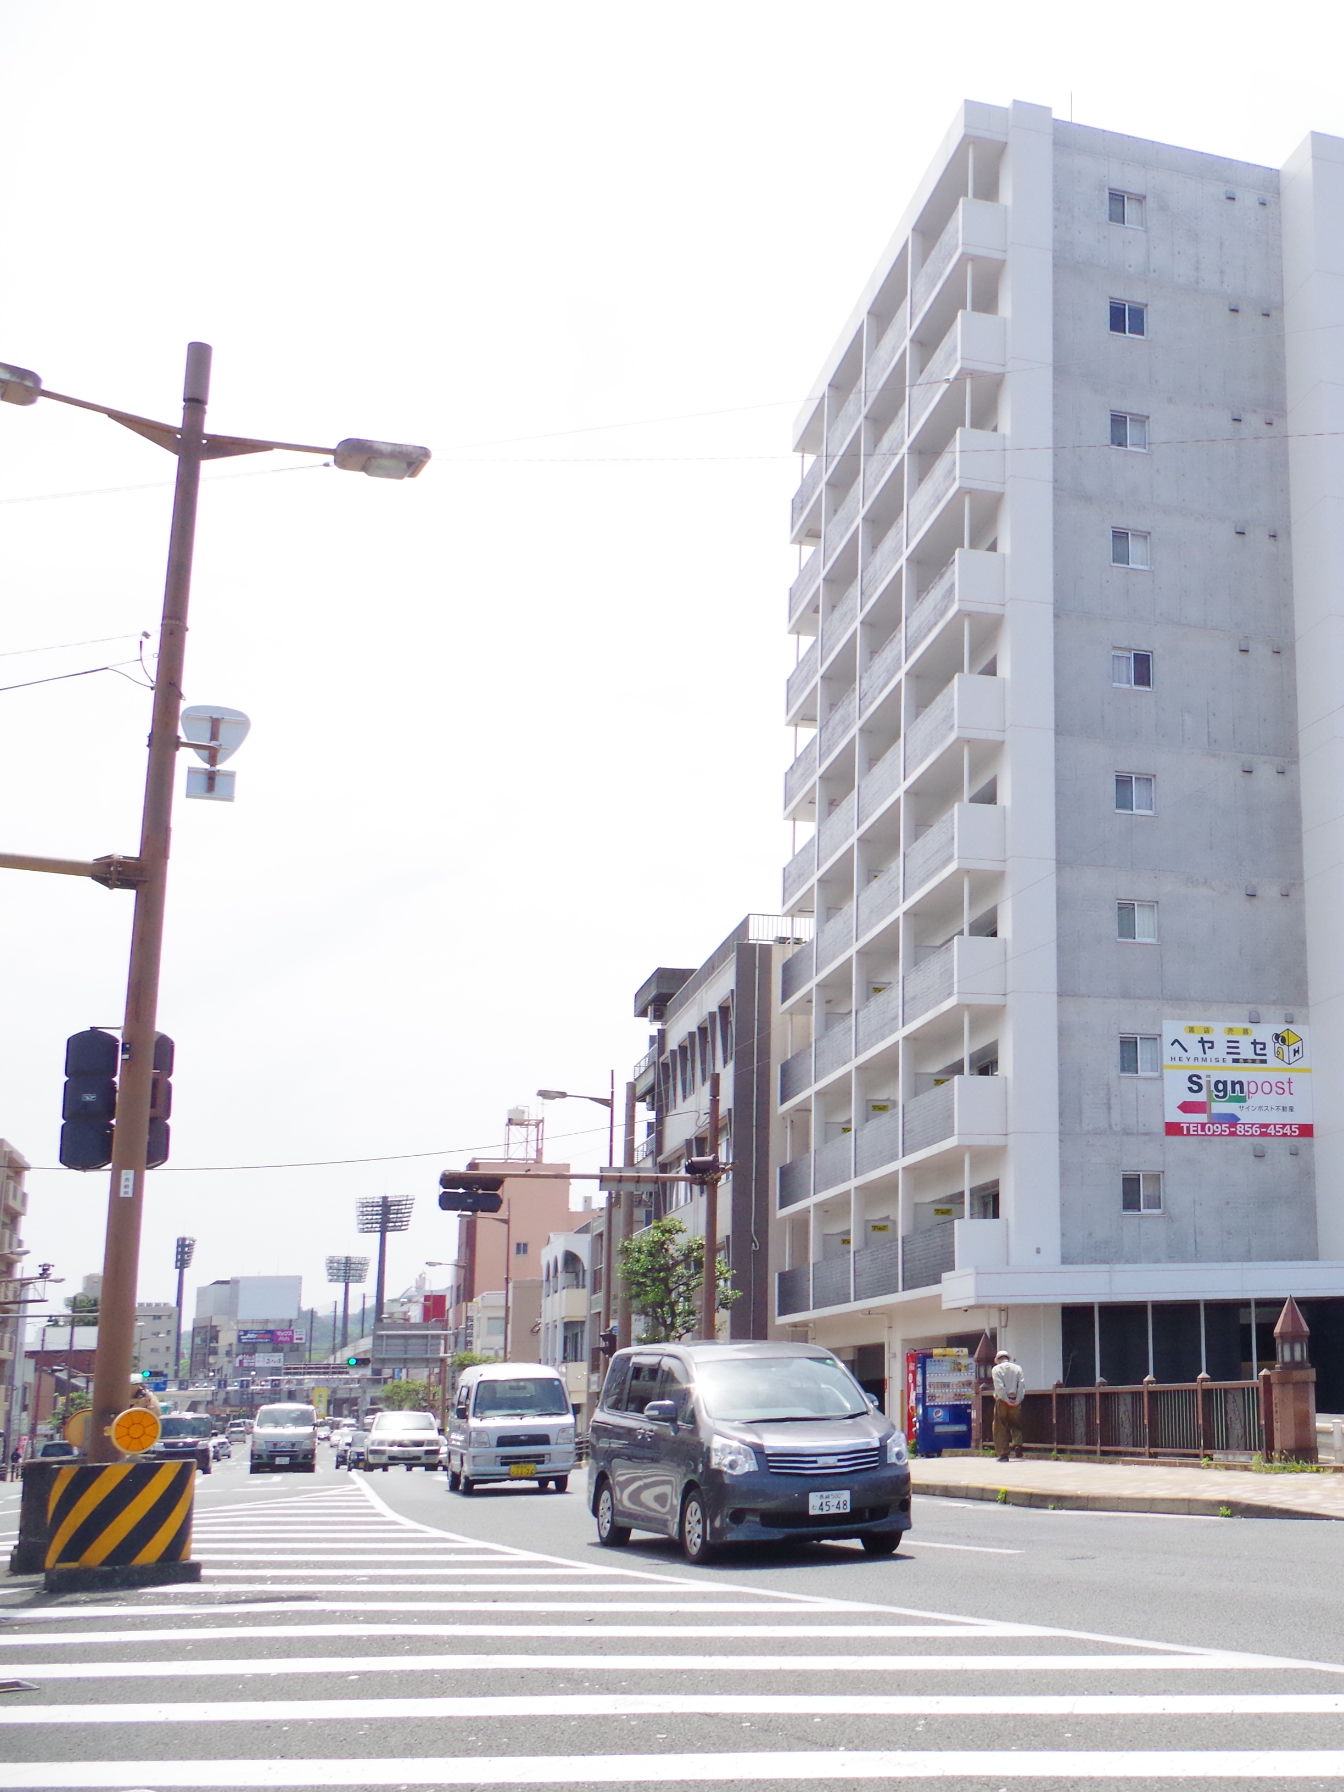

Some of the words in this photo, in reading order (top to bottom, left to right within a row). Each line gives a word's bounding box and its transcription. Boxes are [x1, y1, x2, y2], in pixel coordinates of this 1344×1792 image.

[1170, 1036, 1267, 1057] ヘヤミセ
[1170, 1056, 1227, 1064] HEYAMISE
[1187, 1073, 1294, 1100] Signpost
[1180, 1123, 1300, 1136] TEL095-856-4545
[819, 1500, 848, 1512] 45-48
